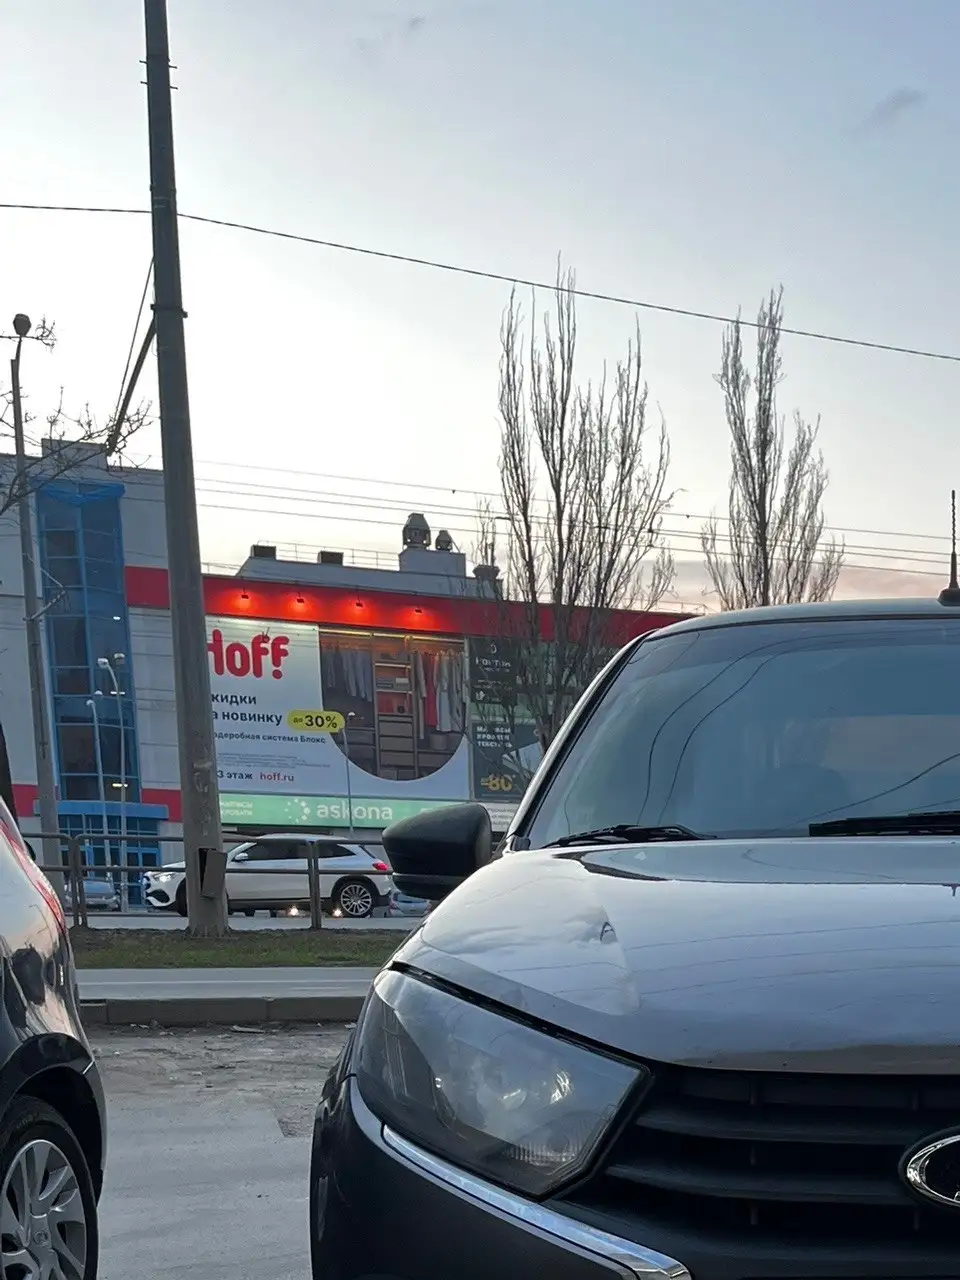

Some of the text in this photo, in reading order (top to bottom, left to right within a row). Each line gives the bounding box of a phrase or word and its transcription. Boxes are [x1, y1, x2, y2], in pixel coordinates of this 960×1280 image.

[212, 694, 257, 706] кидки
[222, 711, 283, 726] новинку
[305, 714, 338, 729] 30%
[262, 734, 299, 743] система
[216, 770, 294, 782] 3 этаж hoff.ru
[316, 801, 393, 820] askona
